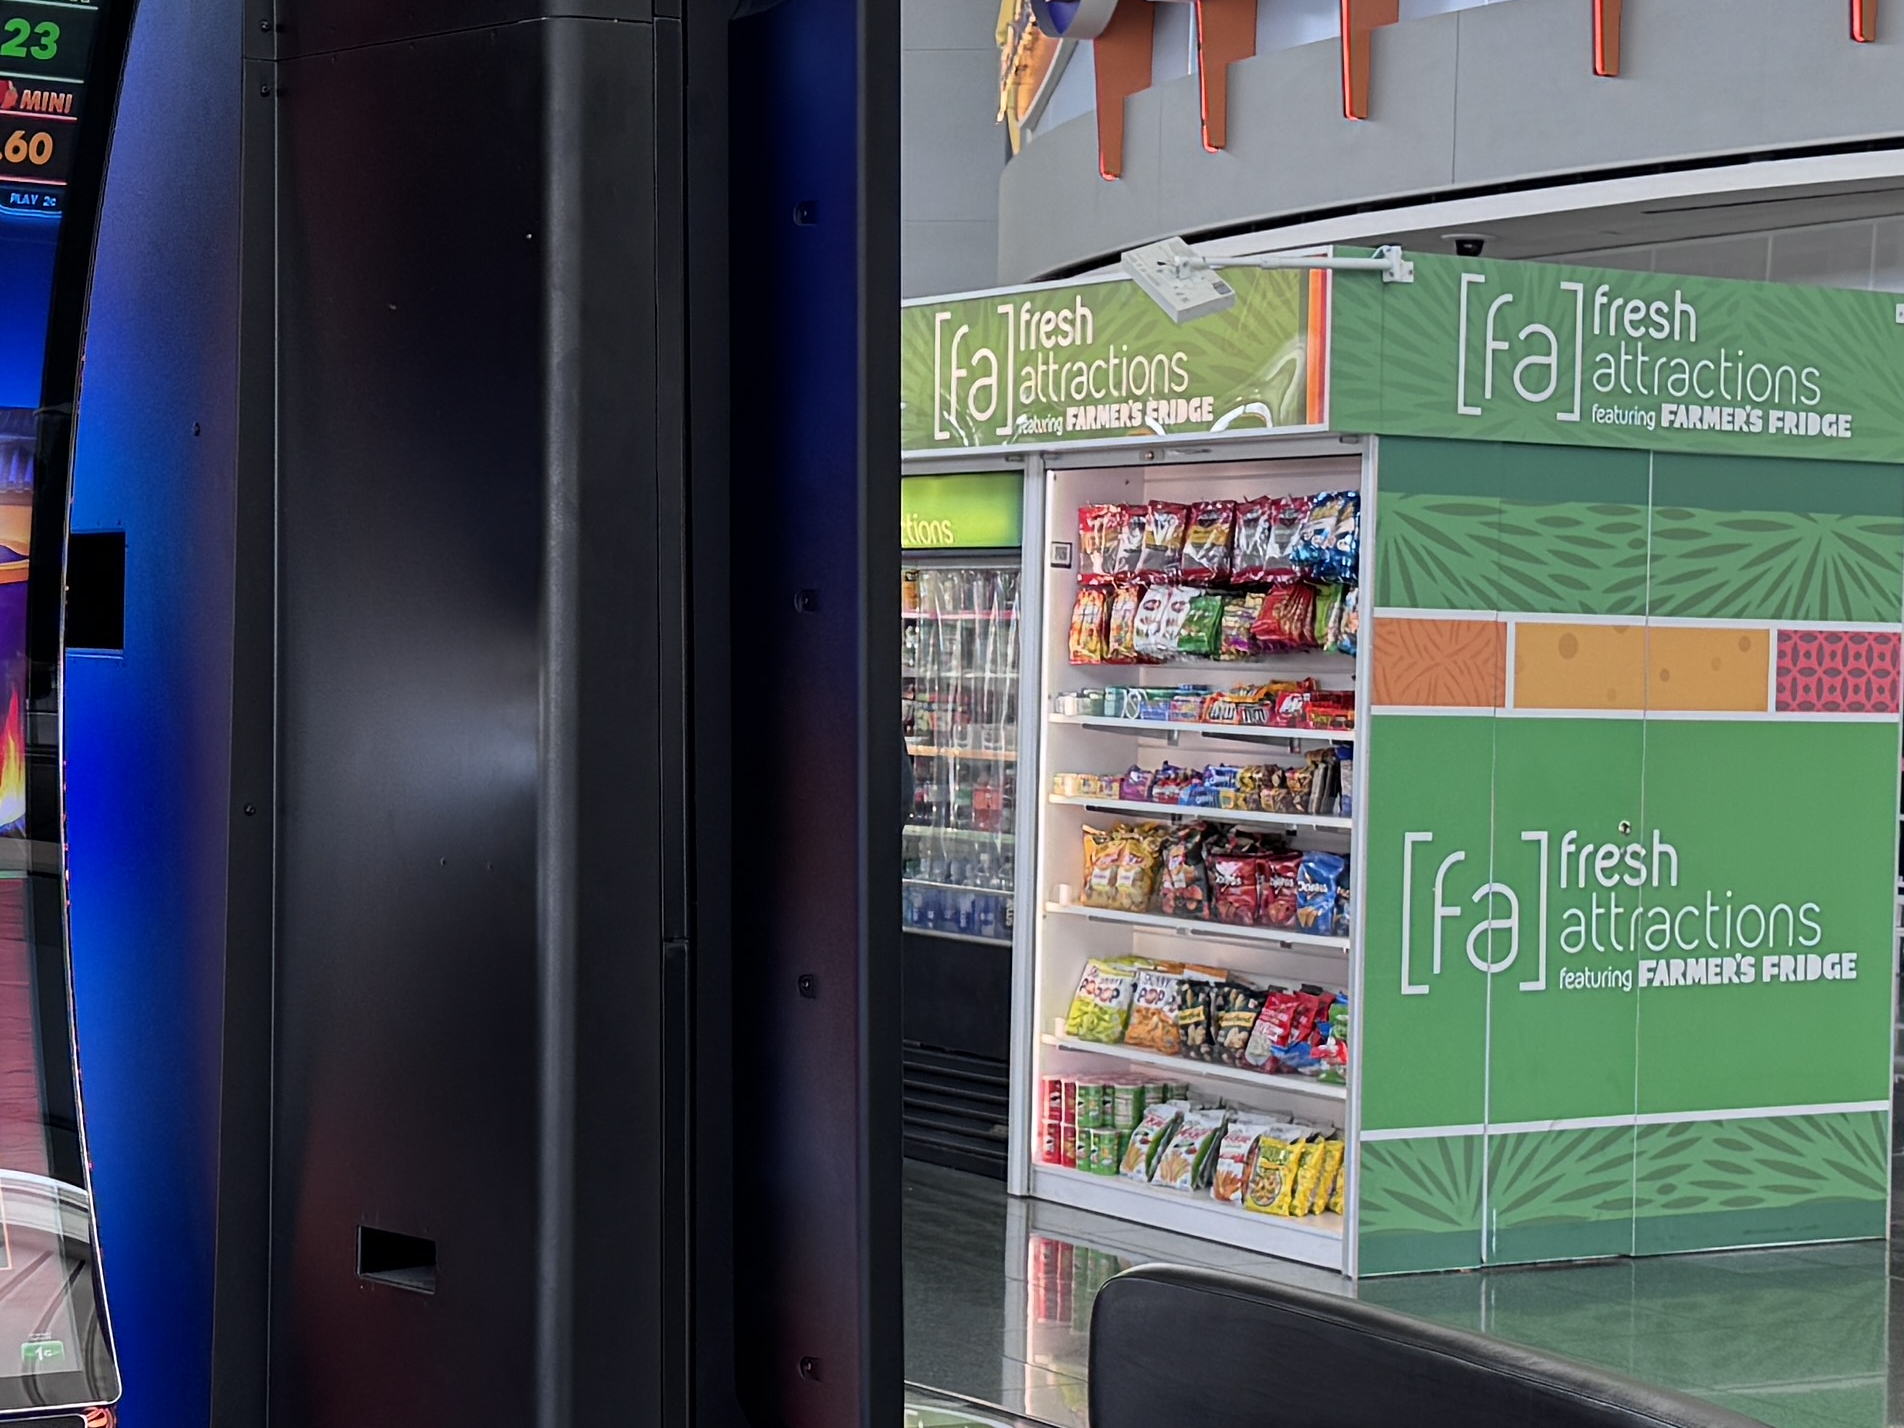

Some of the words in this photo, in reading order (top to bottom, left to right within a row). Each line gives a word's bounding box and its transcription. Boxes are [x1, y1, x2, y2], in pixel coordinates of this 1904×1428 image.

[20, 90, 73, 114] MINI
[1020, 295, 1093, 351] fresh
[1593, 285, 1696, 342] fresh
[1020, 344, 1189, 404] attractions
[1593, 341, 1821, 406] attractions
[1066, 400, 1143, 431] FARMER'S
[1146, 397, 1214, 429] FRIDGE
[1592, 404, 1656, 430] featuring
[1661, 402, 1763, 433] FARMER'S
[1768, 410, 1853, 438] FRIDGE
[901, 514, 956, 545] tions
[1560, 829, 1679, 888] fresh
[1560, 890, 1822, 952] attractions
[1559, 967, 1633, 992] featuring
[1639, 953, 1756, 988] FARMER'S
[1762, 952, 1858, 983] FRIDGE
